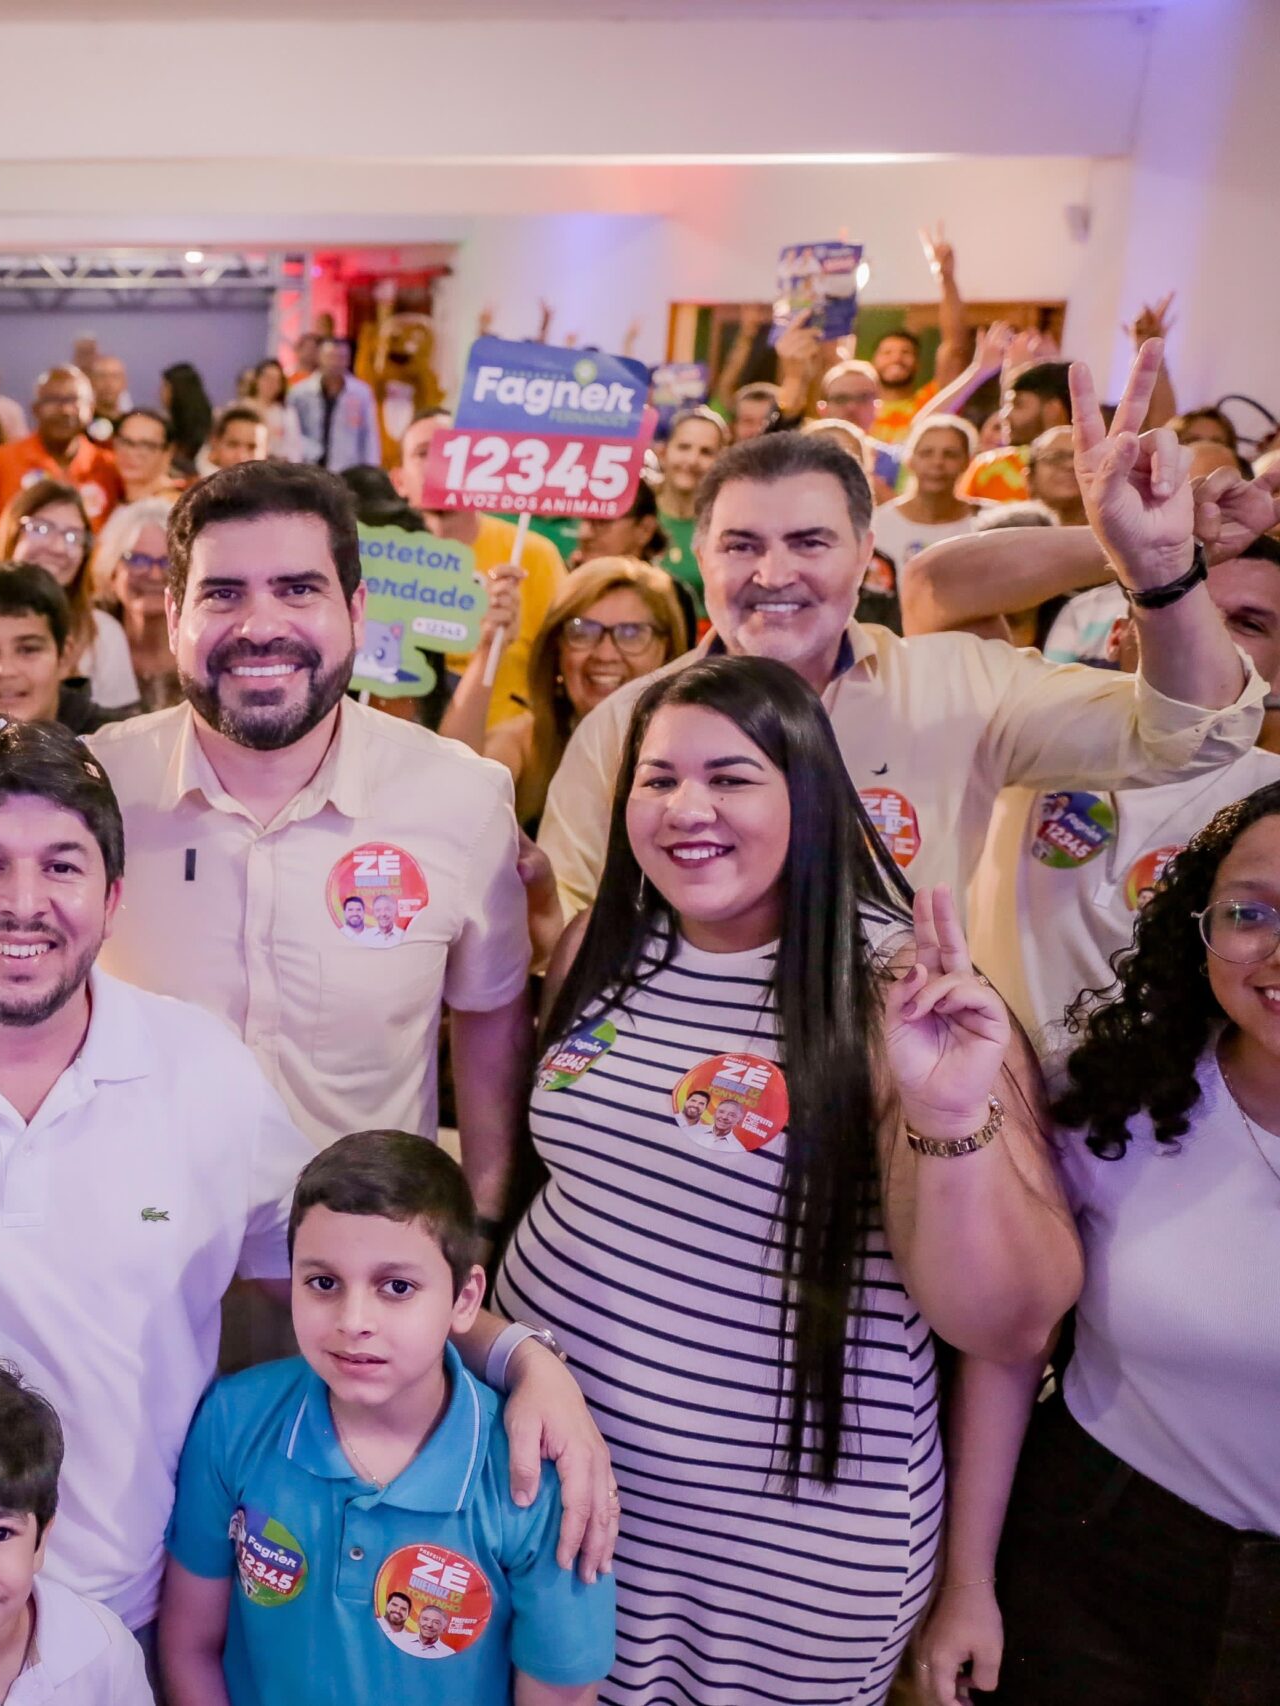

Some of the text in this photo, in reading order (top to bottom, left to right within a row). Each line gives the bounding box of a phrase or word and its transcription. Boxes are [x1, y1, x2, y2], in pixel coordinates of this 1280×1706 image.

[473, 366, 636, 416] Fagner
[442, 435, 633, 500] 12345
[444, 493, 618, 515] A VOZ DOS ANIMAIS
[1045, 822, 1093, 858] 12345
[353, 849, 401, 877] ZÉ
[715, 1059, 773, 1091] ZÉ
[241, 1546, 295, 1590] 12345
[247, 1535, 297, 1568] Fagner
[419, 1547, 446, 1563] PREFEITO
[411, 1552, 471, 1594] ZÉ
[450, 1590, 464, 1604] 12
